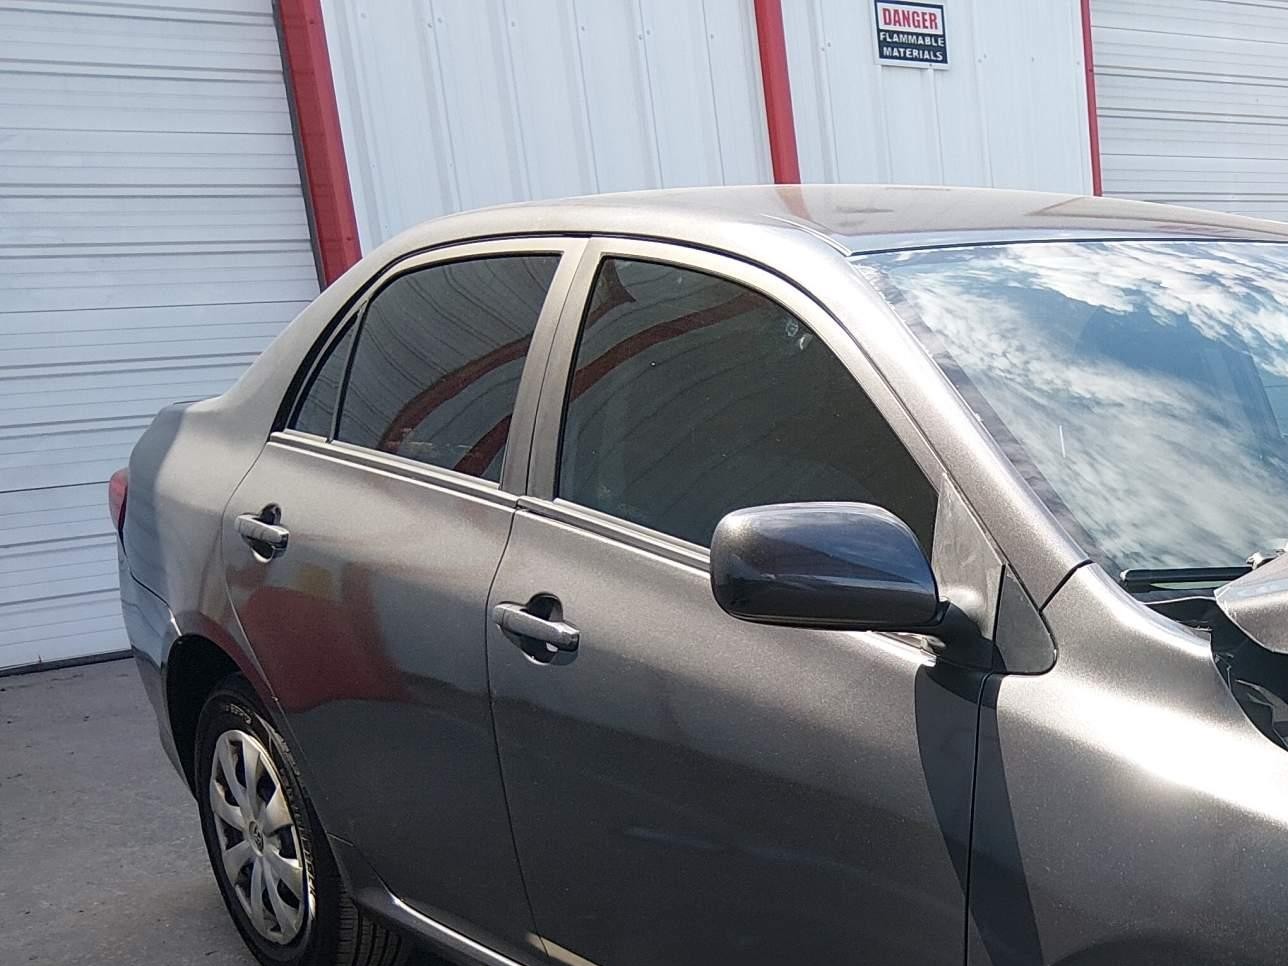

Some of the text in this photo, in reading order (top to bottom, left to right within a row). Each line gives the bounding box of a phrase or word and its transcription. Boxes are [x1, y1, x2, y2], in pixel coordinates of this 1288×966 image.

[882, 7, 938, 30] DANGER
[879, 31, 945, 47] FLAMMABLE
[883, 46, 943, 61] MATERIALS
